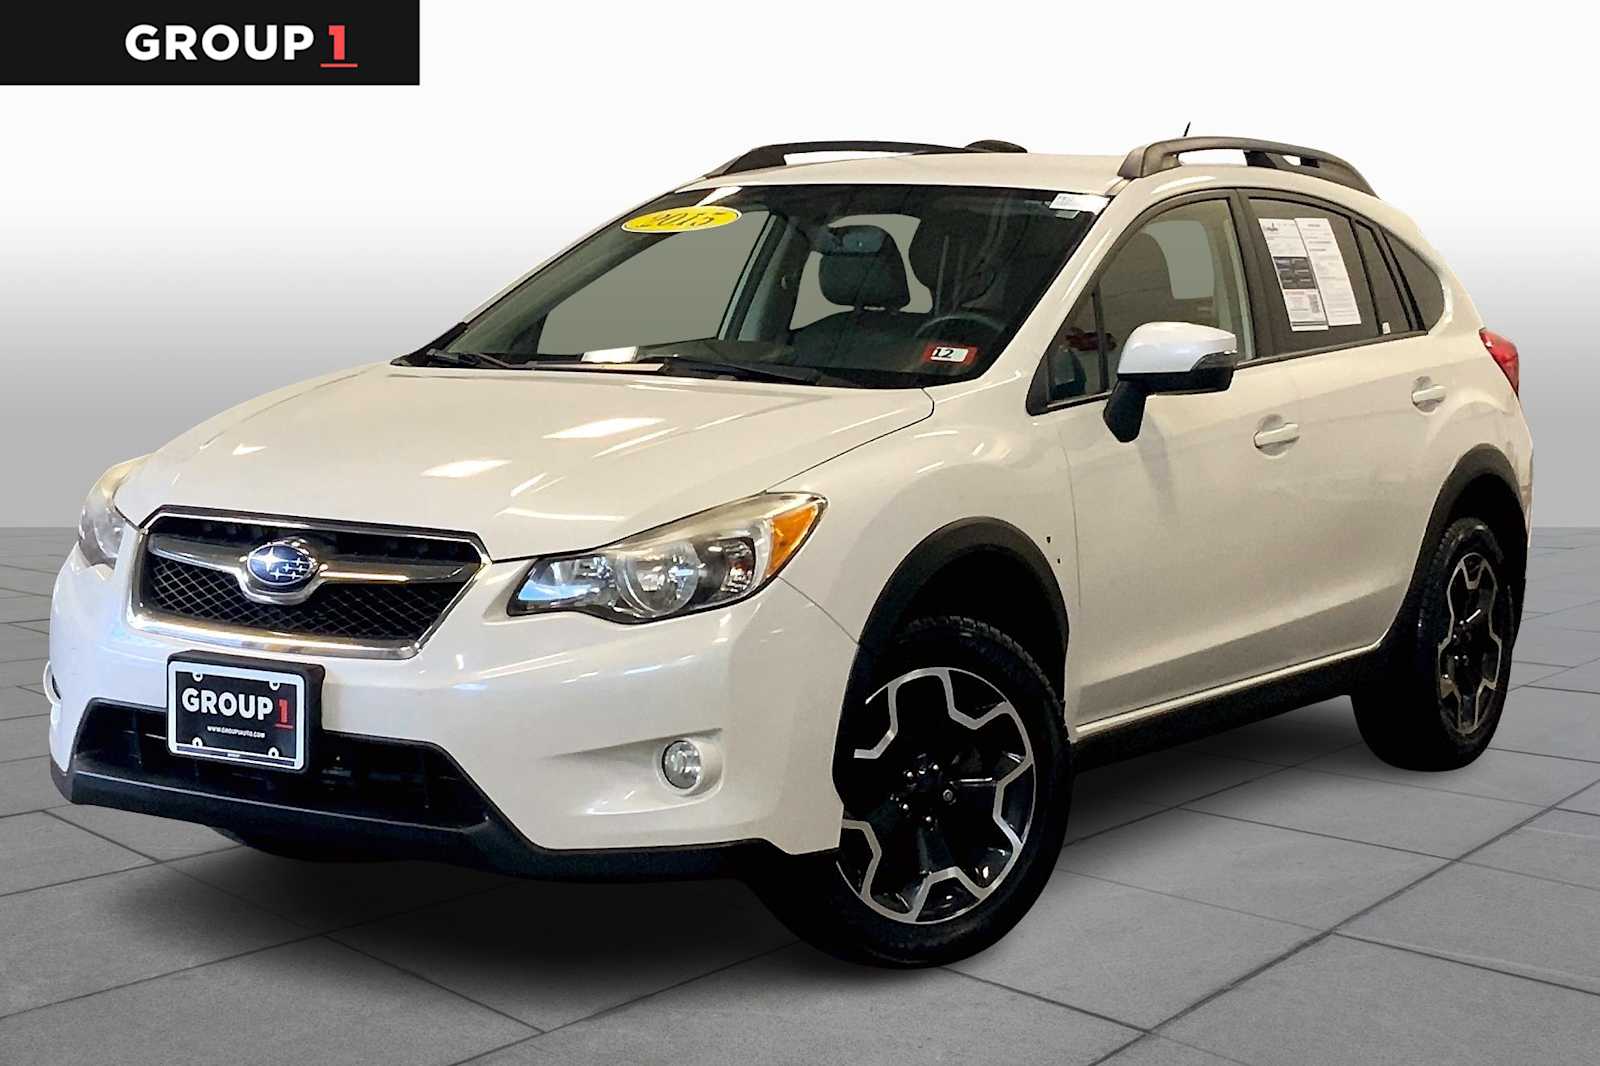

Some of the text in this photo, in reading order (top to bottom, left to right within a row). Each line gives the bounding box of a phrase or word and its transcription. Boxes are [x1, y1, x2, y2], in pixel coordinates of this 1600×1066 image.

[637, 212, 724, 228] 2015
[934, 348, 954, 358] 12
[181, 687, 273, 720] GROUP
